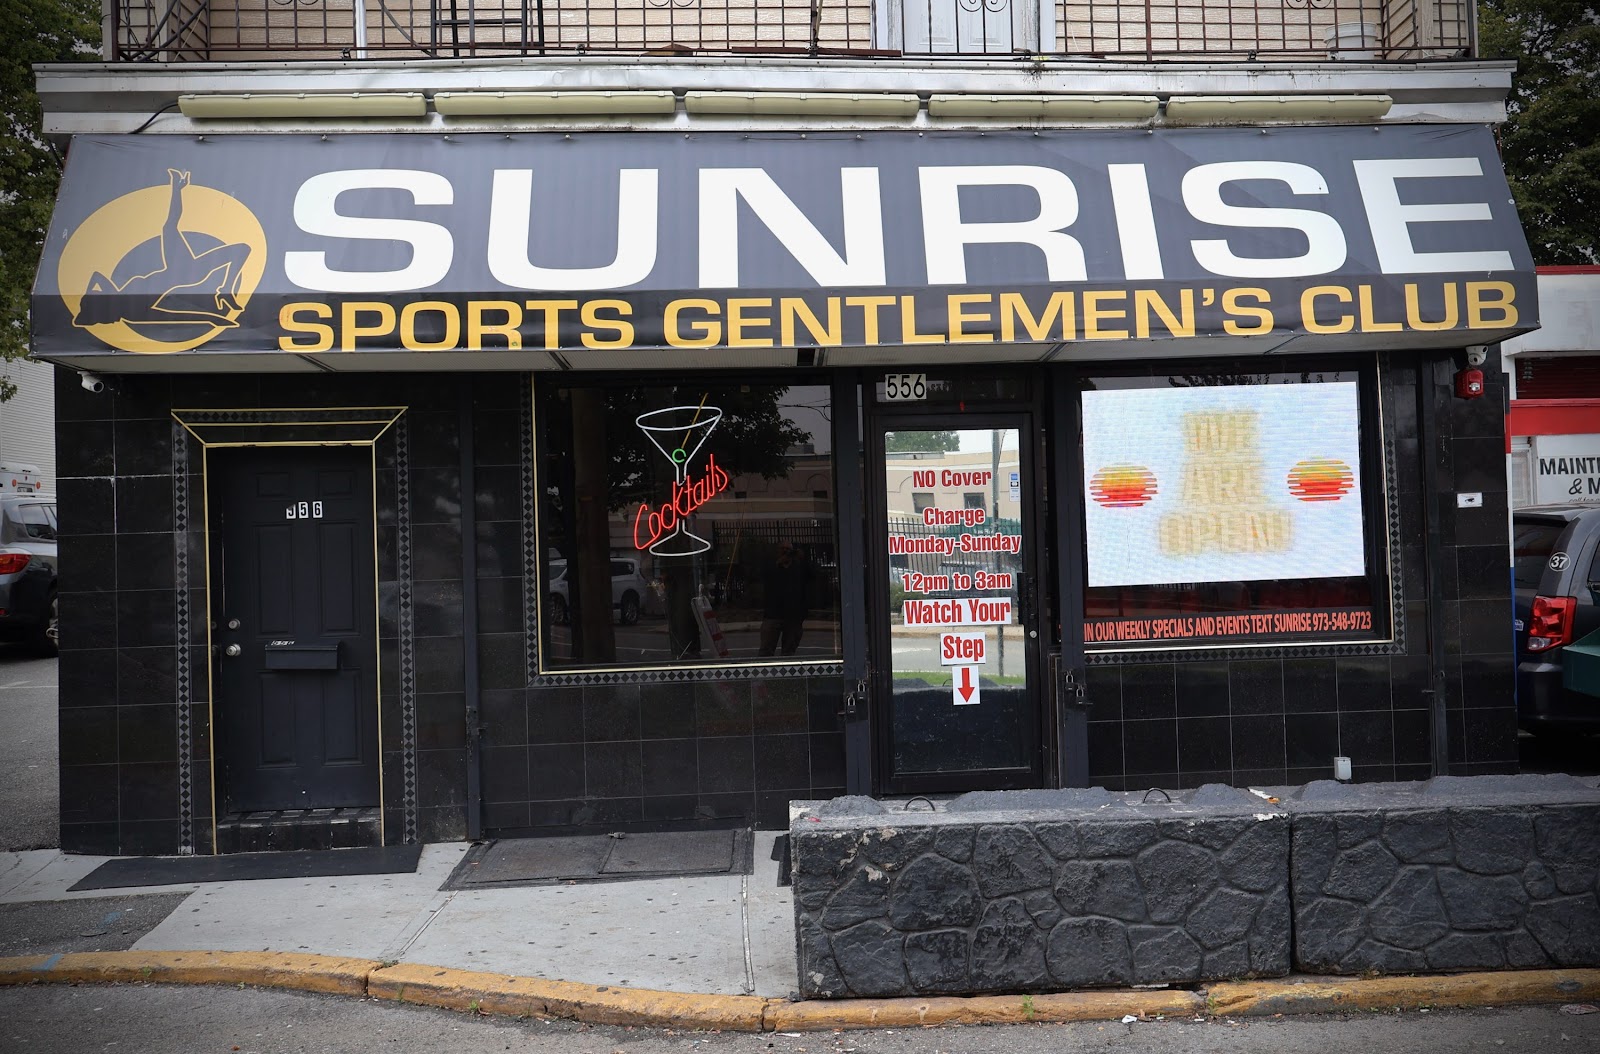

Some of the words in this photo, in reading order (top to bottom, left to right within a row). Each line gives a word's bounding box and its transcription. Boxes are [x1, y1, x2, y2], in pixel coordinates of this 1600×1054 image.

[283, 156, 1515, 292] SUNRISE
[278, 299, 635, 353] SPORTS
[663, 286, 1273, 349] GENTLEMEN'S
[1301, 281, 1518, 335] CLUB
[887, 374, 925, 398] 556
[913, 470, 936, 488] NO
[941, 469, 992, 487] Cover
[1568, 477, 1583, 495] &
[634, 453, 728, 550] Cocktails
[923, 507, 985, 527] Charge
[889, 533, 1022, 556] Monday-Sunday
[1551, 556, 1568, 569] 37
[901, 572, 950, 594] 12pm
[953, 573, 971, 591] to
[974, 571, 1012, 591] 3am
[904, 600, 963, 624] Watch
[968, 599, 1011, 623] Your
[1096, 622, 1116, 640] OUR
[1116, 620, 1151, 639] WEEKLY
[1152, 617, 1194, 638] SPECIALS
[1195, 616, 1214, 636] AND
[1216, 614, 1250, 635] EVENTS
[1250, 613, 1273, 633] TEXT
[1274, 612, 1311, 632] SUNRISE
[1312, 610, 1372, 631] 973-548-9723
[943, 635, 985, 661] Step
